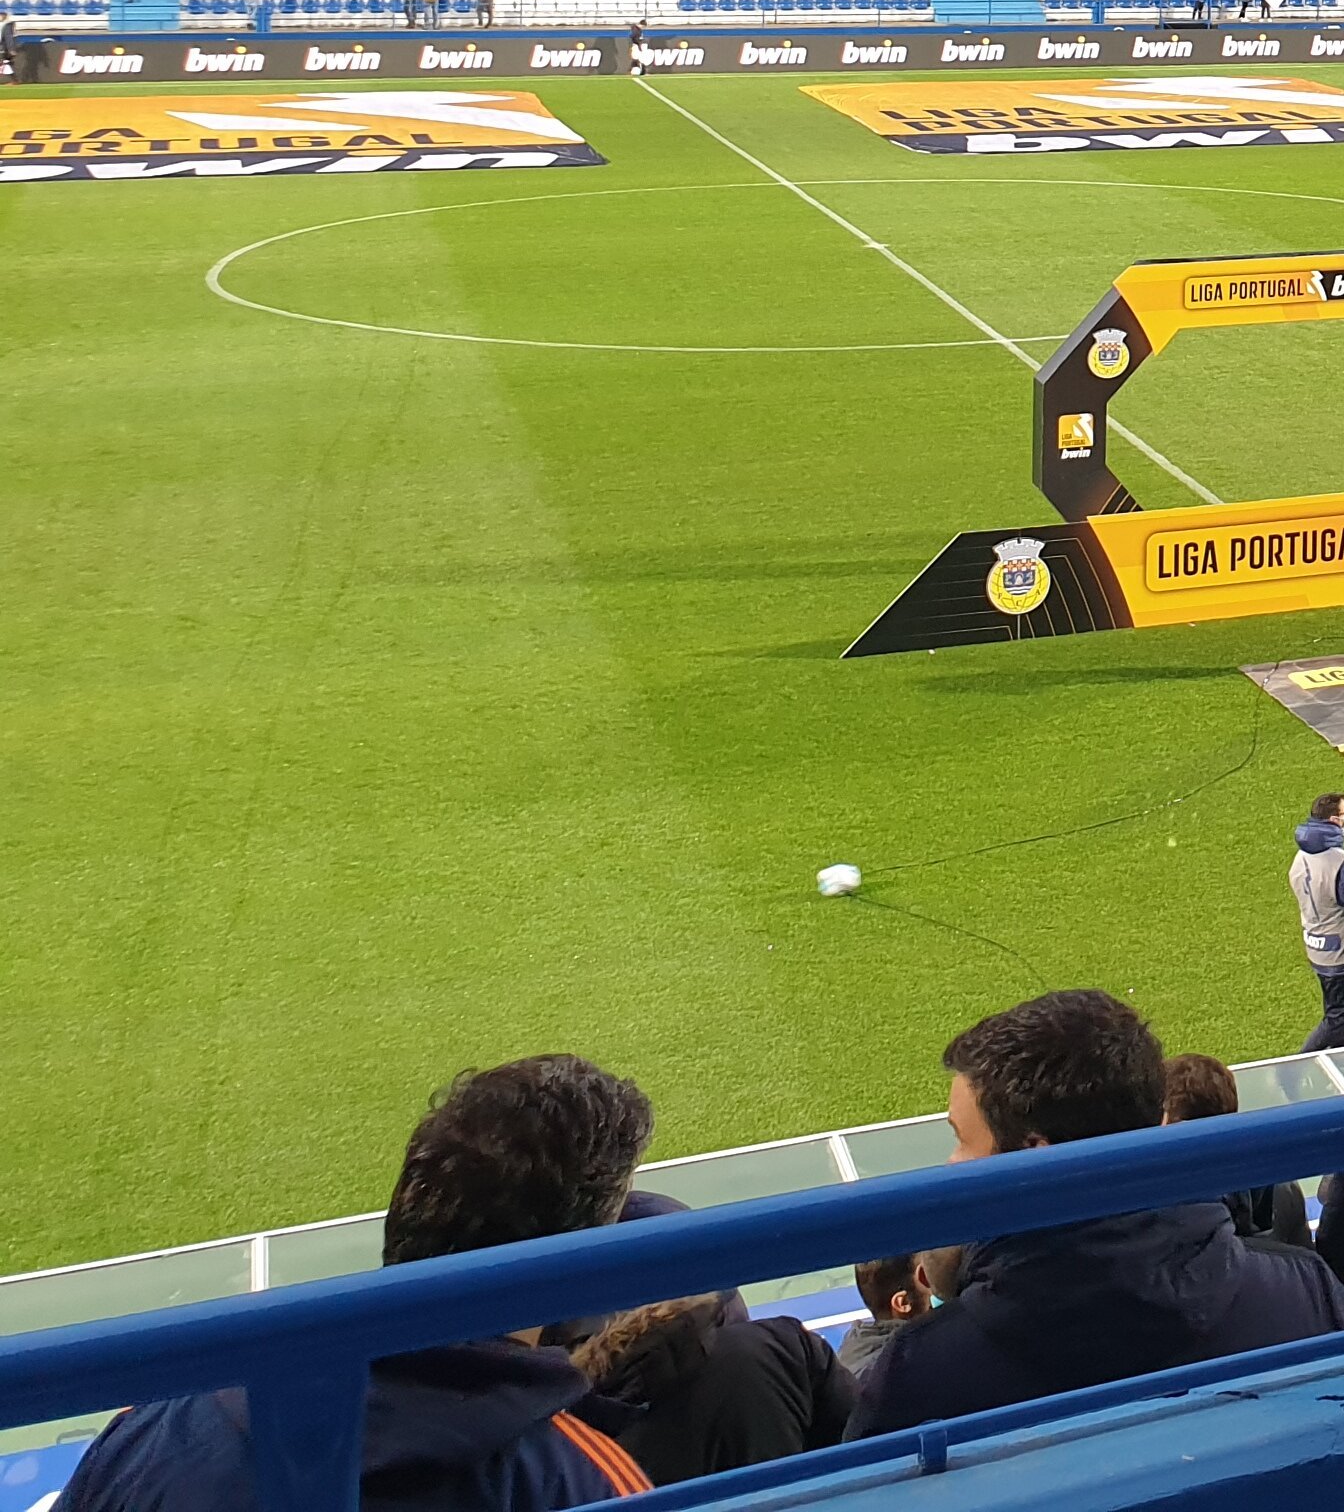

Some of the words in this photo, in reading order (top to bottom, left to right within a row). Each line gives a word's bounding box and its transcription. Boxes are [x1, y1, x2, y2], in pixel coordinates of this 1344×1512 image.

[304, 44, 381, 70] bwin
[419, 44, 494, 70] bwin
[530, 42, 602, 68] bwin
[738, 40, 807, 65] bwin
[841, 39, 907, 65] bwin
[940, 38, 1005, 62] bwin
[1037, 36, 1100, 60] bwin
[1132, 34, 1193, 59] bwin
[1222, 34, 1281, 57] bwin
[59, 46, 144, 75] bwin
[184, 46, 265, 74] bwin
[879, 107, 1071, 121] LIGA
[902, 110, 1342, 132] PORTUGAL
[0, 134, 463, 156] ORTUGAL
[11, 127, 145, 141] GA
[1190, 282, 1223, 302] LIGA
[1229, 278, 1304, 300] PORTUGAL
[1060, 447, 1091, 460] bwin
[1158, 539, 1218, 579] LIGA
